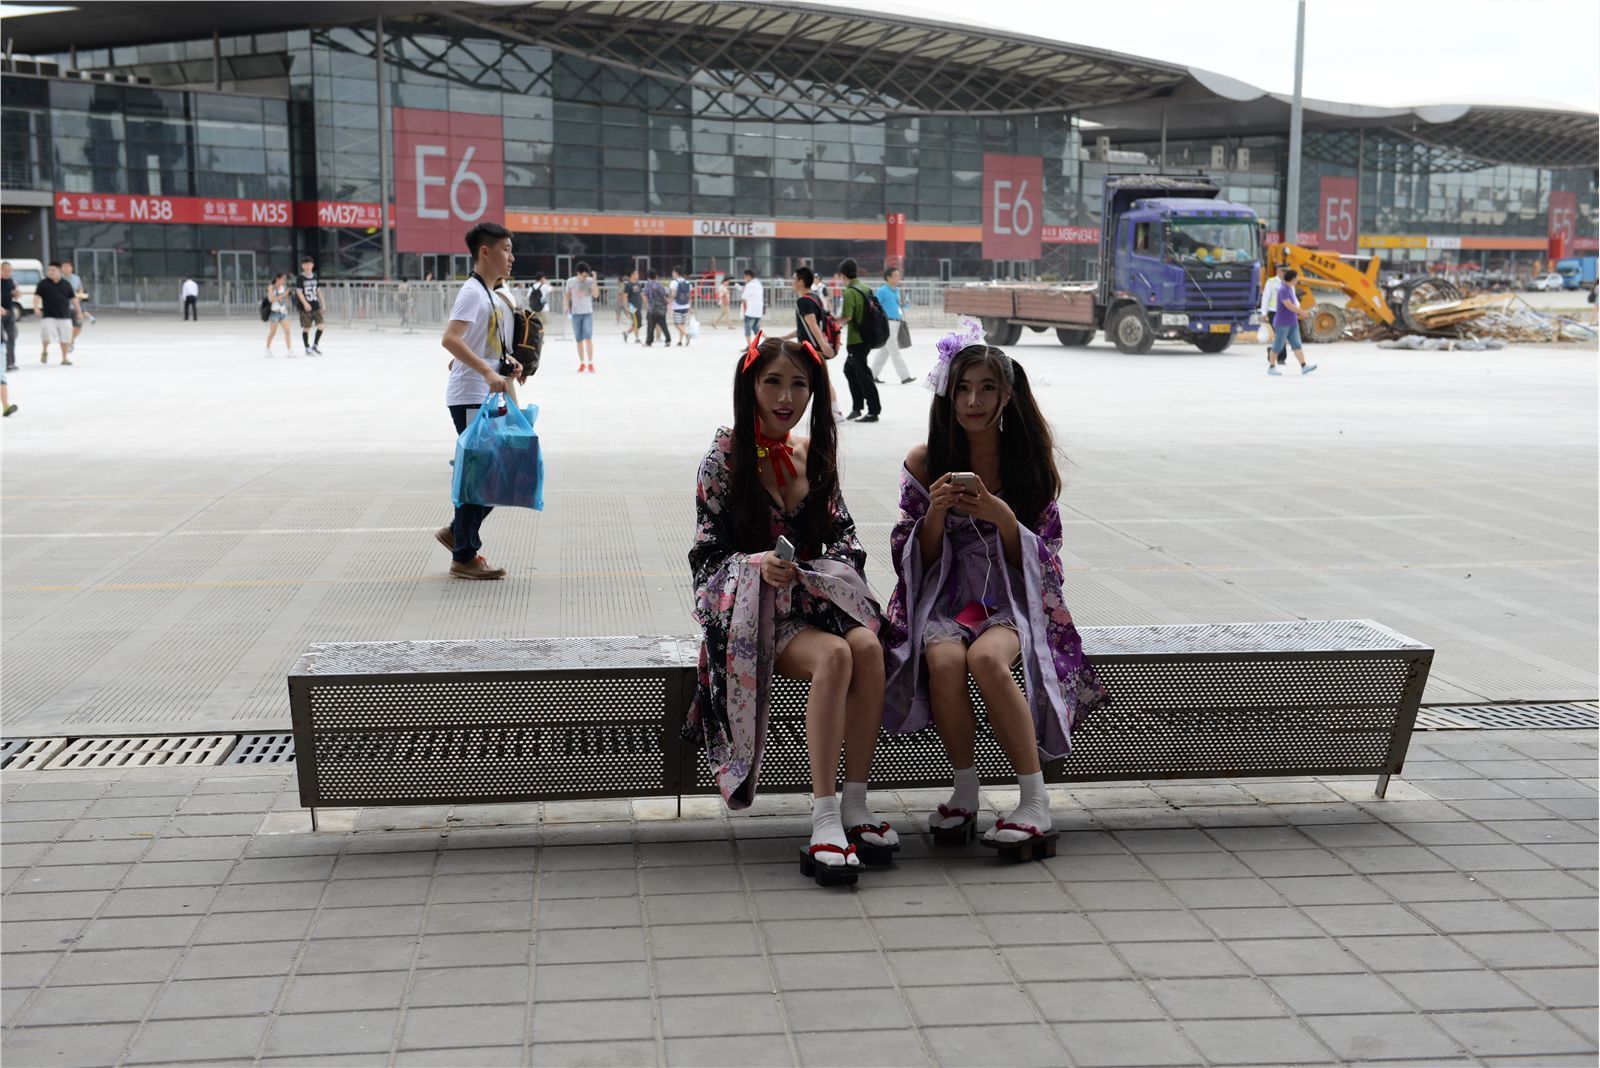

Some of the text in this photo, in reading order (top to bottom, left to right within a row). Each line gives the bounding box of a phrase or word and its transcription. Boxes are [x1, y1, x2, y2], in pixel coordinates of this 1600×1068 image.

[415, 144, 488, 222] E6
[129, 198, 173, 221] M38
[251, 202, 288, 223] M35
[327, 203, 358, 224] M37
[993, 180, 1034, 237] E6
[1325, 197, 1353, 242] E5
[1206, 270, 1232, 280] JAC
